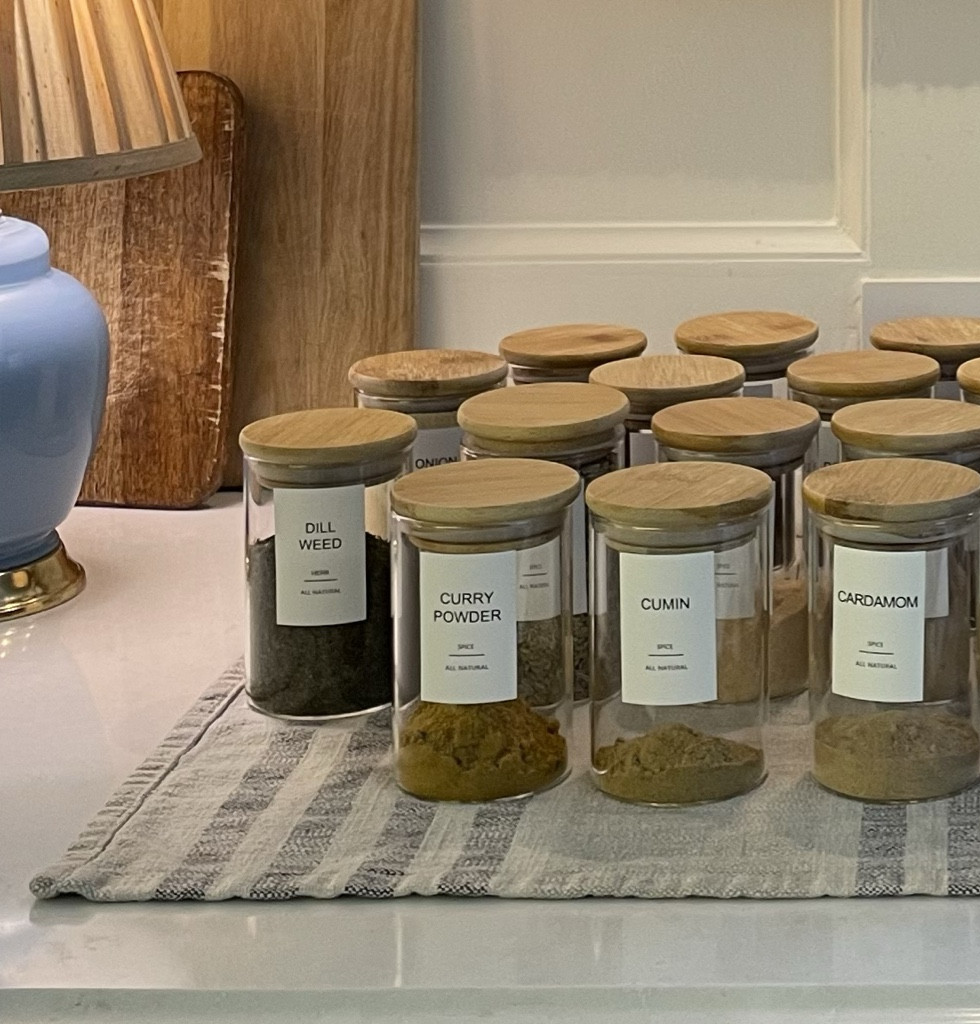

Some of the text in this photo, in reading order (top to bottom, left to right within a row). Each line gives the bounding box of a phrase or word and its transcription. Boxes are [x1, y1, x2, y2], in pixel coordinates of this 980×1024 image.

[305, 522, 336, 534] DILL
[299, 538, 342, 550] WEED
[440, 591, 494, 605] CURRY
[641, 598, 690, 610] CUMIN
[838, 590, 918, 608] CARDAMOM
[433, 609, 502, 623] POWDER
